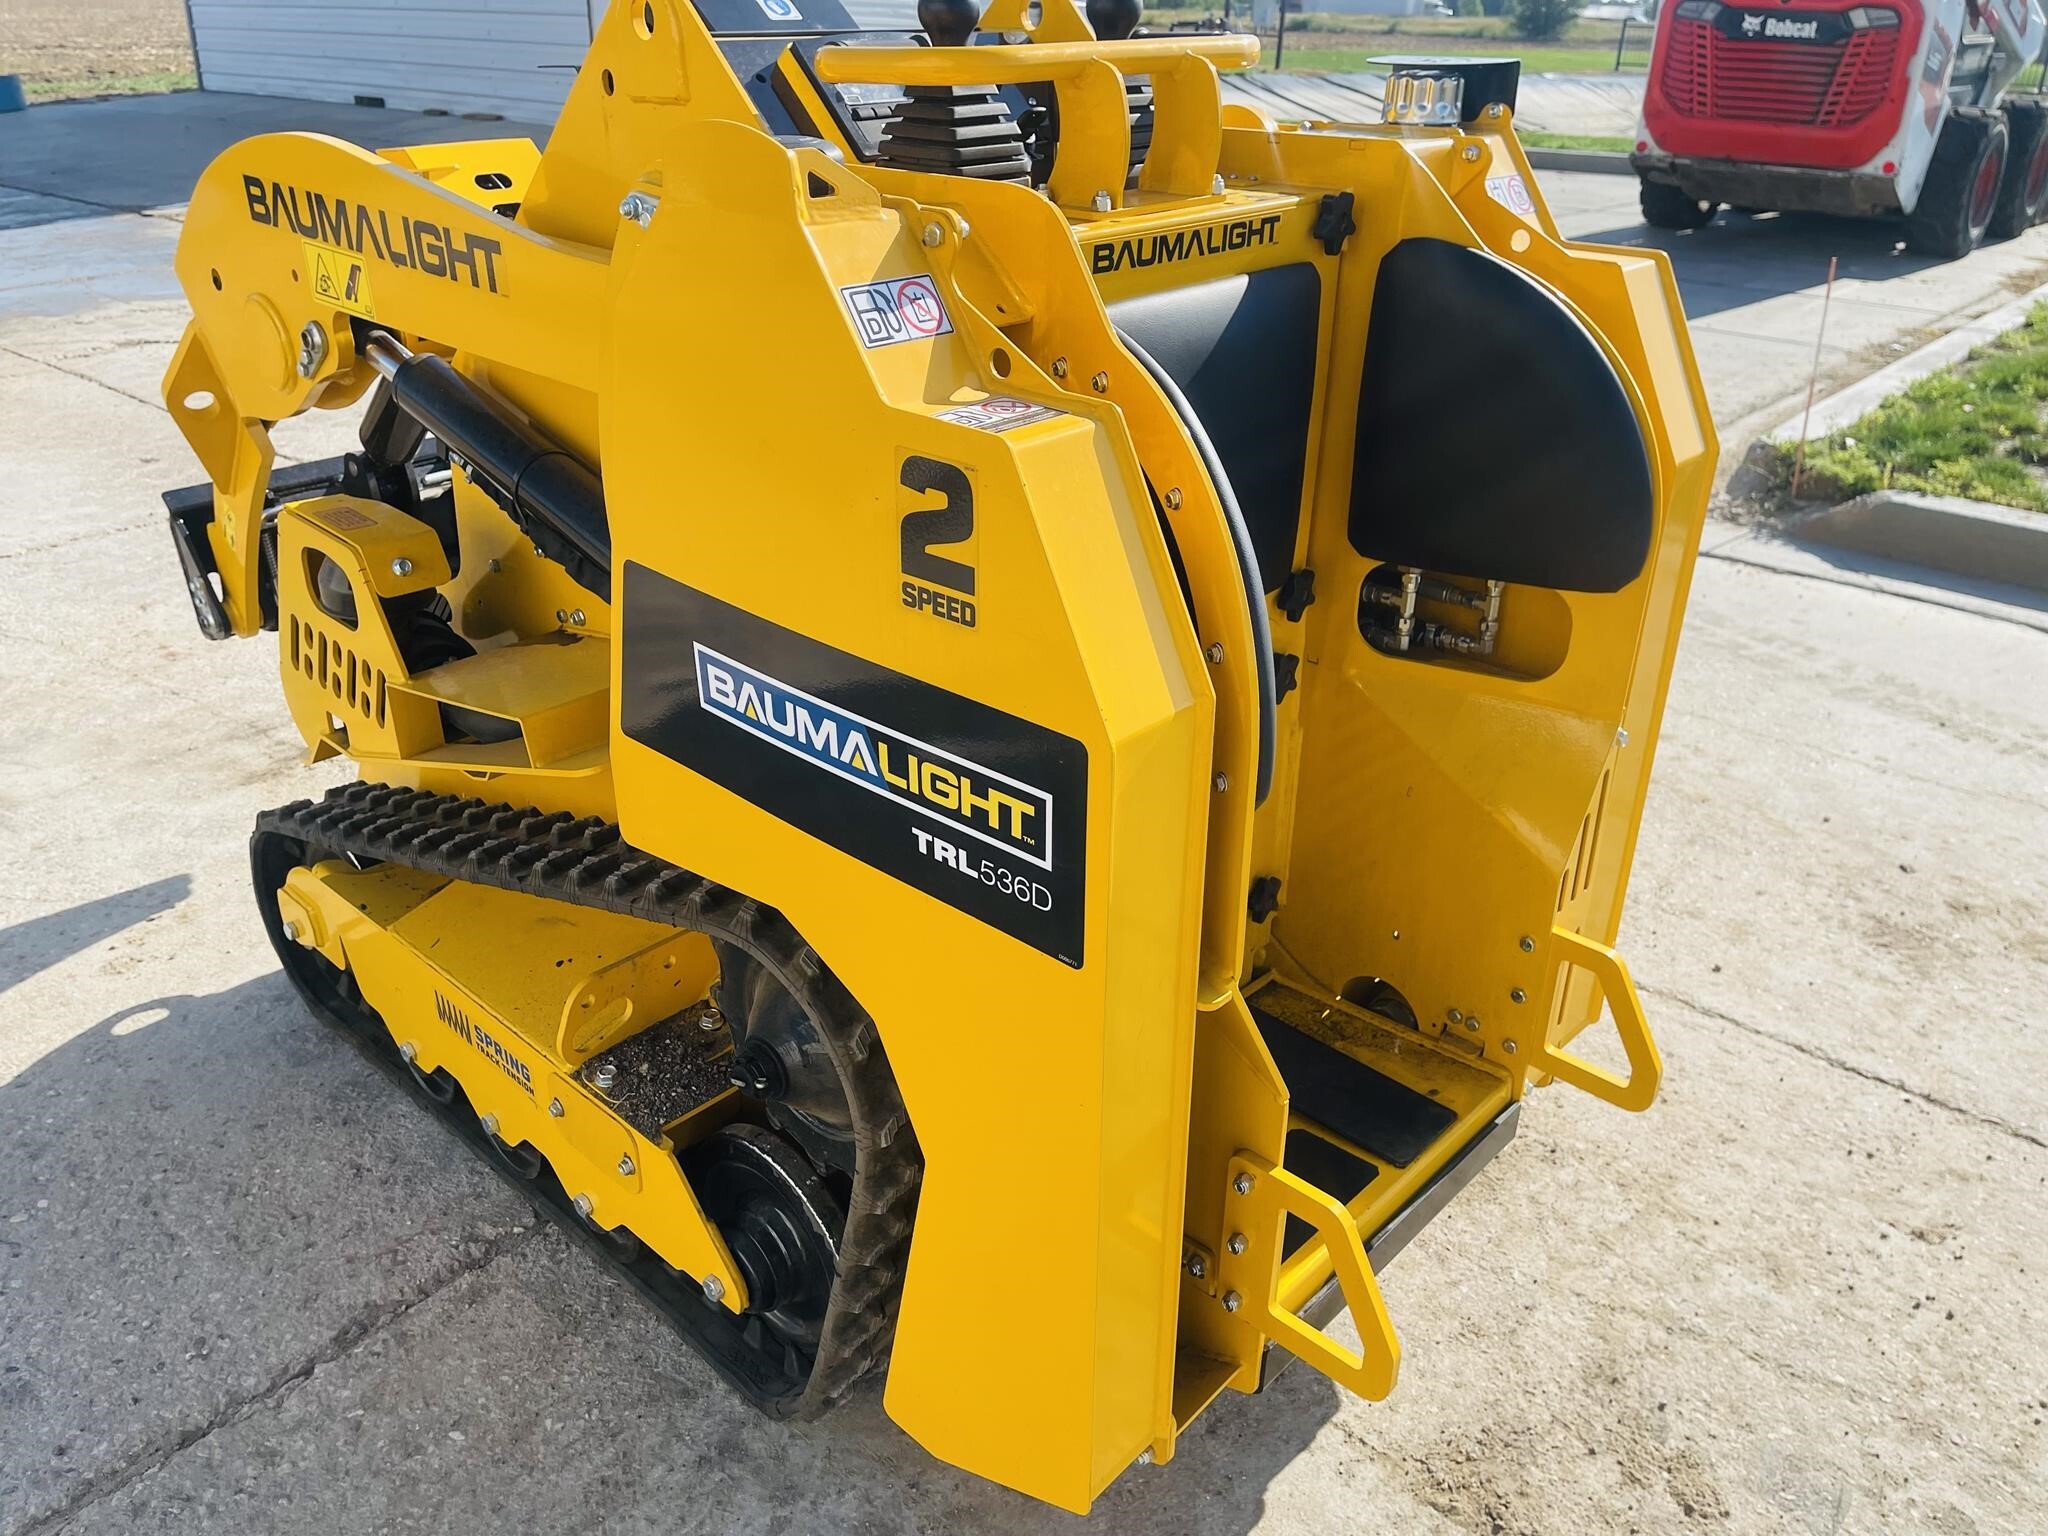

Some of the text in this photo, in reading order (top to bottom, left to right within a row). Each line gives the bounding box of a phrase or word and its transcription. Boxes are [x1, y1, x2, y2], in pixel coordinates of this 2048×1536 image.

[1764, 18, 1818, 39] Bobcat
[242, 173, 502, 294] BAUMALIGHT
[1092, 215, 1281, 275] BAUMALIGHT
[900, 455, 975, 596] 2
[901, 581, 976, 628] SPEED
[706, 663, 1035, 840] BAUMALIGHT
[911, 826, 1053, 912] TRL536D
[473, 1023, 531, 1084] SPRING
[475, 1040, 536, 1097] TRACK TENSION
